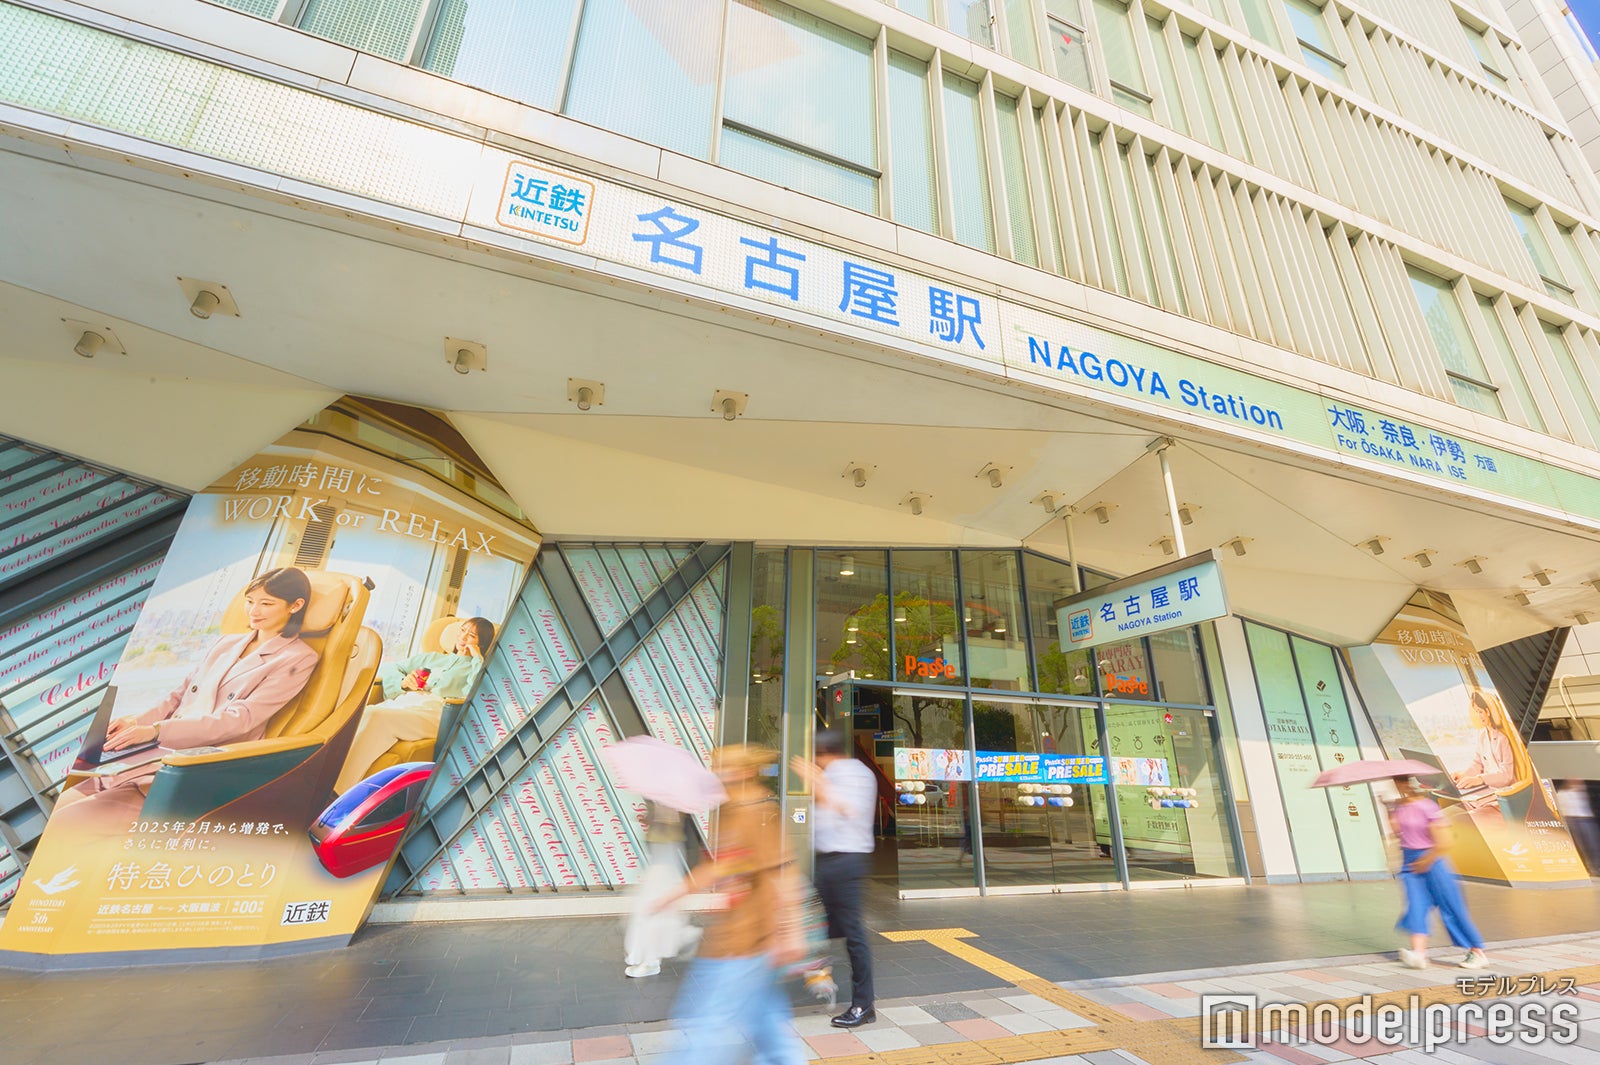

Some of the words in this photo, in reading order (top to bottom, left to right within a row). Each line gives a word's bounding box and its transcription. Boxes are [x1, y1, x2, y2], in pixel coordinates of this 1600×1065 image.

[511, 173, 585, 217] 近鉄
[509, 204, 579, 232] KINTETSU
[631, 206, 986, 350] 名古屋駅
[1028, 336, 1170, 400] NAGOYA
[1178, 379, 1283, 430] Station
[1327, 404, 1467, 464] 大阪・奈良・伊勢
[1473, 454, 1498, 473] 方面
[1337, 434, 1357, 450] For
[1409, 453, 1444, 474] NARA
[1447, 464, 1467, 480] ISE
[236, 463, 382, 496] 移動時間に
[223, 496, 327, 523] WORK
[335, 511, 366, 528] or
[379, 508, 497, 556] RELAX
[1100, 576, 1201, 622] 名古屋駅
[1070, 615, 1090, 630] 近鉄
[1118, 619, 1152, 632] NAGOYA
[1153, 610, 1183, 623] Station
[1397, 629, 1464, 646] 移動時間に
[1401, 648, 1459, 664] WORK
[518, 776, 542, 816] Vega
[560, 753, 577, 780] Vega
[575, 781, 605, 836] Celebrity
[565, 723, 597, 782] Samantha
[594, 784, 612, 814] Vega
[609, 814, 641, 869] Celebrity
[123, 838, 216, 851] さらに便利に。
[128, 821, 289, 835] 2025年2月から増発で、
[107, 861, 277, 891] 特急ひのとり
[32, 912, 49, 925] 5th
[283, 902, 329, 923] 近鉄
